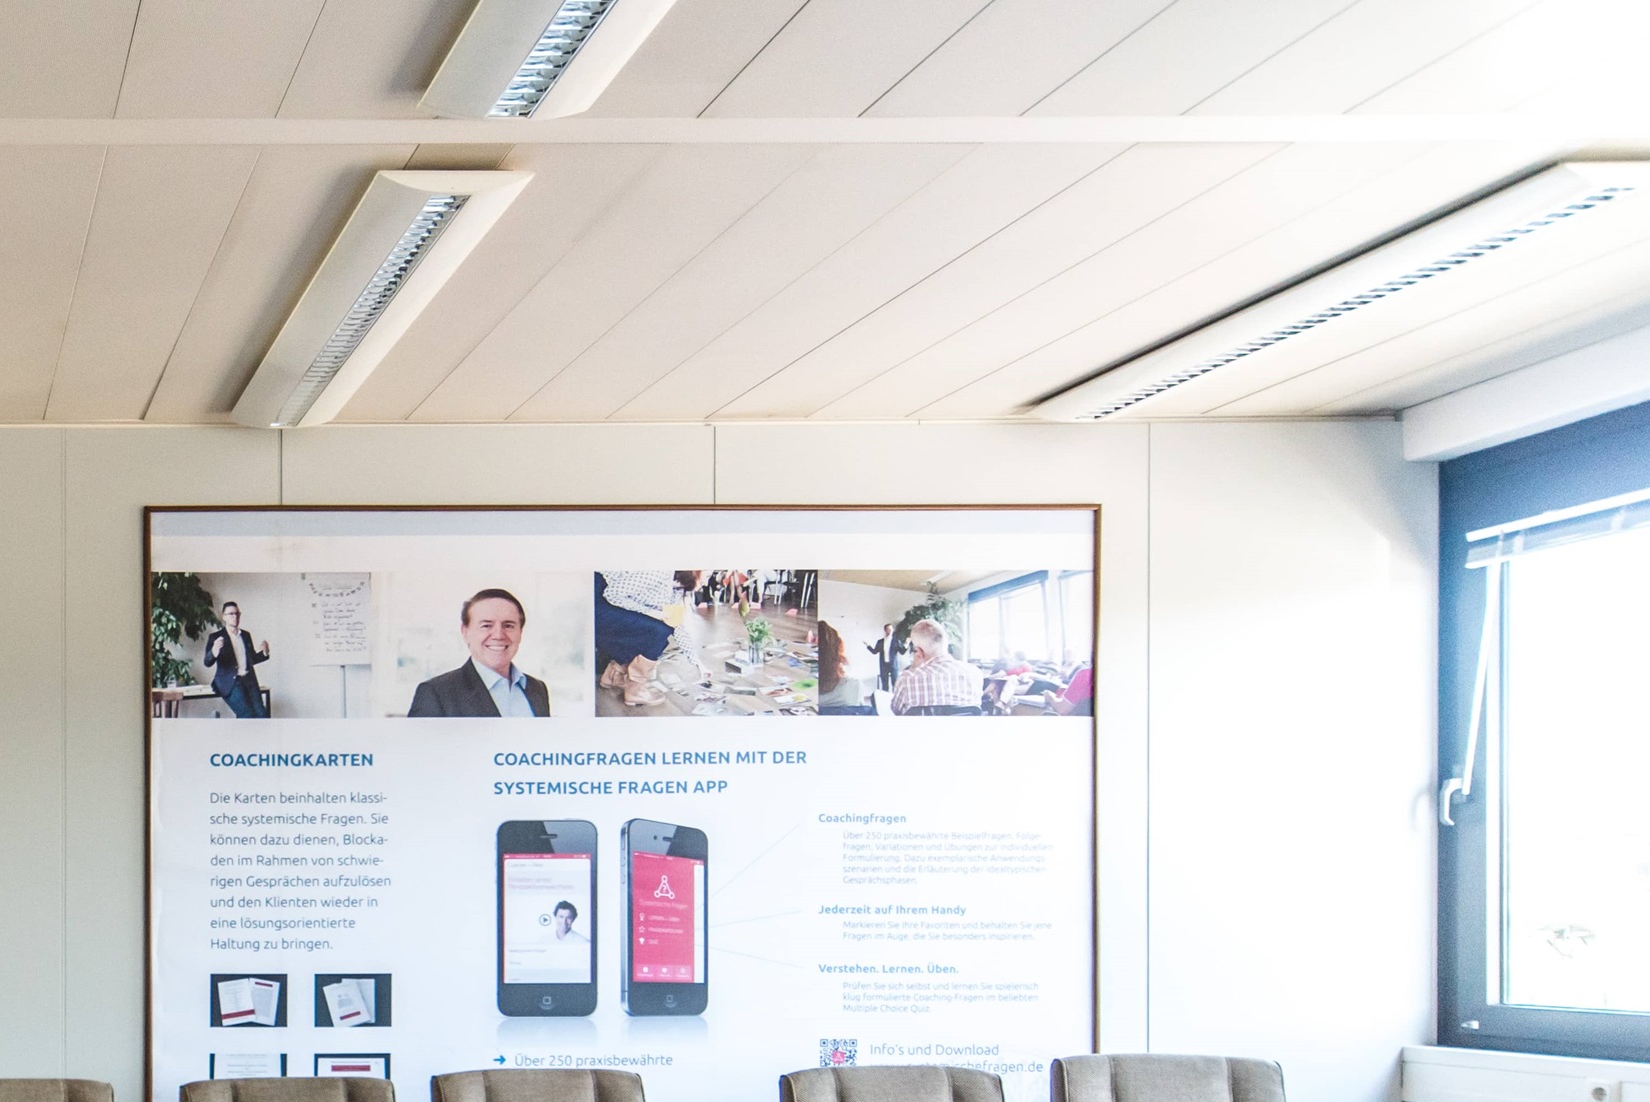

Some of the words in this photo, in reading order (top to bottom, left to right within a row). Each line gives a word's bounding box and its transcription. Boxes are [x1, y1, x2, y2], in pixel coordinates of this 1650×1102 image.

[209, 753, 374, 768] COACHINGKARTEN
[493, 752, 657, 766] COACHINGFRAGEN
[661, 751, 731, 766] LERNEN
[735, 750, 768, 764] MIT
[772, 750, 808, 764] DER
[493, 781, 613, 796] SYSTEMISCHE
[618, 780, 688, 795] FRAGEN
[692, 780, 728, 794] APP
[209, 792, 232, 804] Die
[233, 792, 277, 804] Karten
[279, 791, 348, 804] beinhalten
[349, 791, 388, 804] klassi-
[209, 812, 238, 825] sche
[240, 812, 318, 828] systemische
[320, 812, 368, 828] Fragen.
[370, 812, 390, 825] Sie
[818, 812, 907, 826] Coachingfragen
[209, 833, 258, 846] können
[259, 833, 290, 846] dazu
[292, 833, 340, 847] dienen,
[342, 833, 389, 846] Blocka-
[209, 854, 235, 867] den
[236, 854, 254, 866] im
[256, 854, 308, 867] Rahmen
[310, 856, 335, 867] von
[336, 854, 385, 867] schwie-
[210, 875, 243, 890] rigen
[245, 875, 320, 890] Gesprächen
[322, 874, 392, 888] aufzulösen
[209, 896, 235, 908] und
[237, 896, 262, 908] den
[264, 896, 318, 908] Klienten
[319, 896, 365, 908] wieder
[366, 896, 379, 908] in
[818, 904, 872, 915] Jederzeit
[874, 904, 893, 915] auf
[896, 904, 928, 915] Ihrem
[931, 904, 967, 917] Handy
[209, 917, 238, 929] eine
[240, 916, 357, 932] lösungsorientierte
[210, 937, 261, 953] Haltung
[262, 940, 279, 950] zu
[280, 937, 334, 953] bringen.
[818, 963, 879, 974] Verstehen.
[882, 964, 924, 974] Lernen.
[927, 962, 959, 974] Üben.
[907, 1043, 932, 1056] und
[934, 1043, 1000, 1056] Download
[514, 1052, 546, 1068] Über
[548, 1054, 573, 1068] 250
[575, 1053, 674, 1069] praxisbewährte
